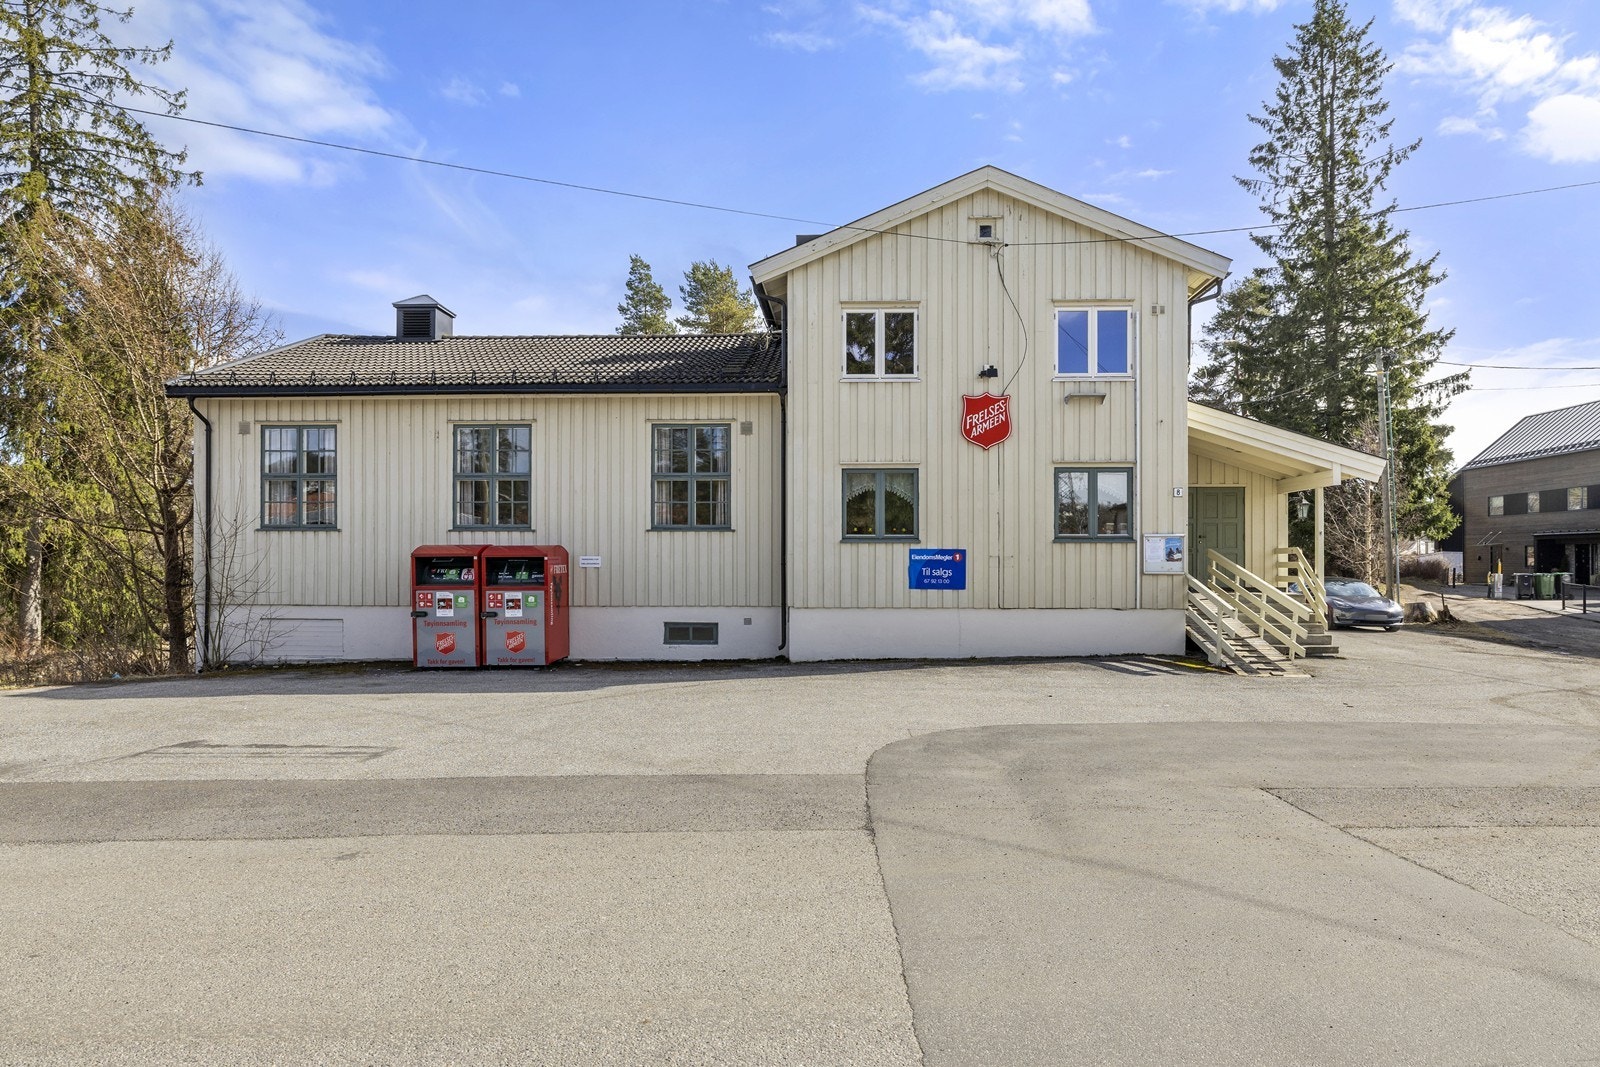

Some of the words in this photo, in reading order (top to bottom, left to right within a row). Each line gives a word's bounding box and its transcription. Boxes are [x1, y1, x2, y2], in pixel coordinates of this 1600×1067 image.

[966, 400, 1006, 429] FRELSES-
[970, 411, 1006, 438] ARMEEN
[922, 567, 930, 576] Til
[932, 568, 952, 578] salgs
[424, 620, 468, 628] Tøyinnsamling
[494, 618, 538, 626] Tøyinnsamling
